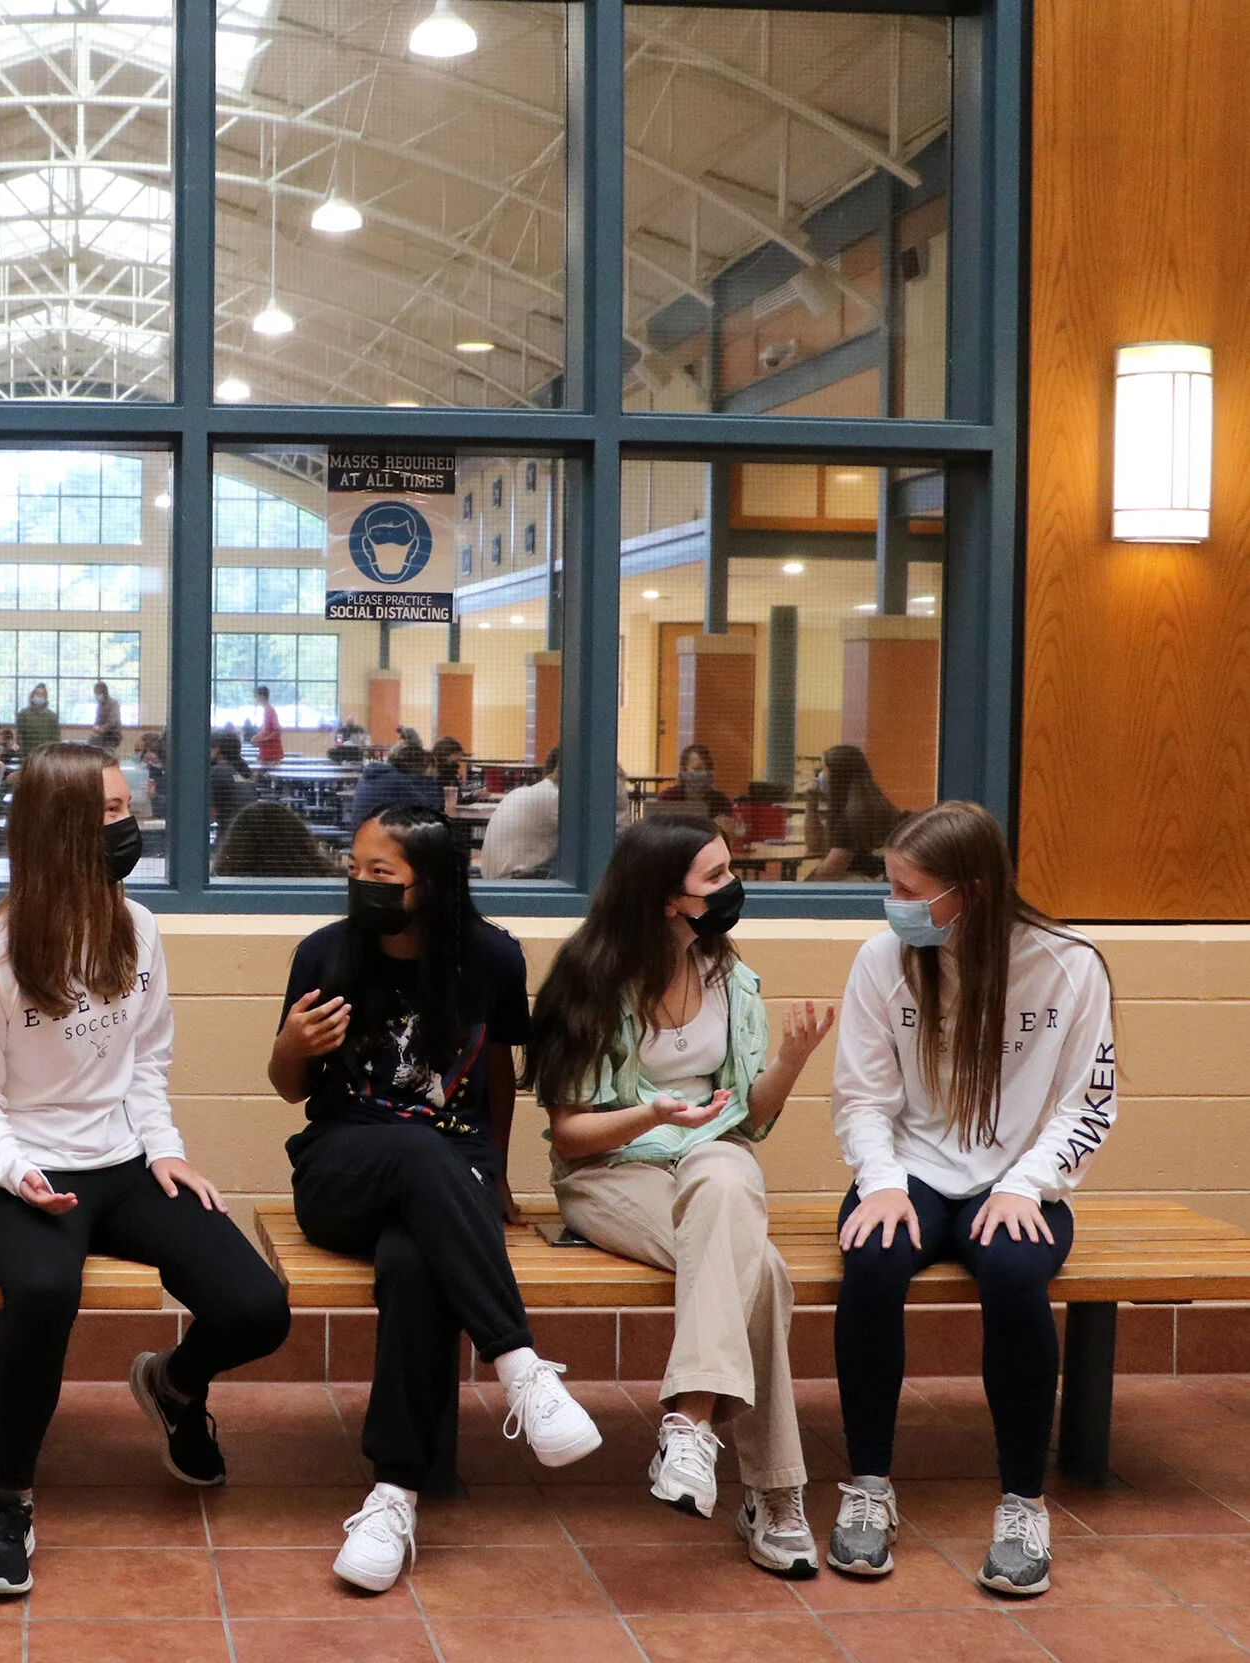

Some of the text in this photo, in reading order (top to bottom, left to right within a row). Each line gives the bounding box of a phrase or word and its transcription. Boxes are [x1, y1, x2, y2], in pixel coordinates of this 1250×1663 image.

[330, 455, 455, 471] MASKS REQUIRED
[339, 473, 445, 488] AT ALL TIMES
[347, 594, 432, 606] PLEASE PRACTICE
[330, 605, 449, 620] SOCIAL DISTANCING
[24, 971, 150, 1028] EER
[64, 1009, 128, 1040] SOCCER
[901, 1007, 1059, 1032] EER
